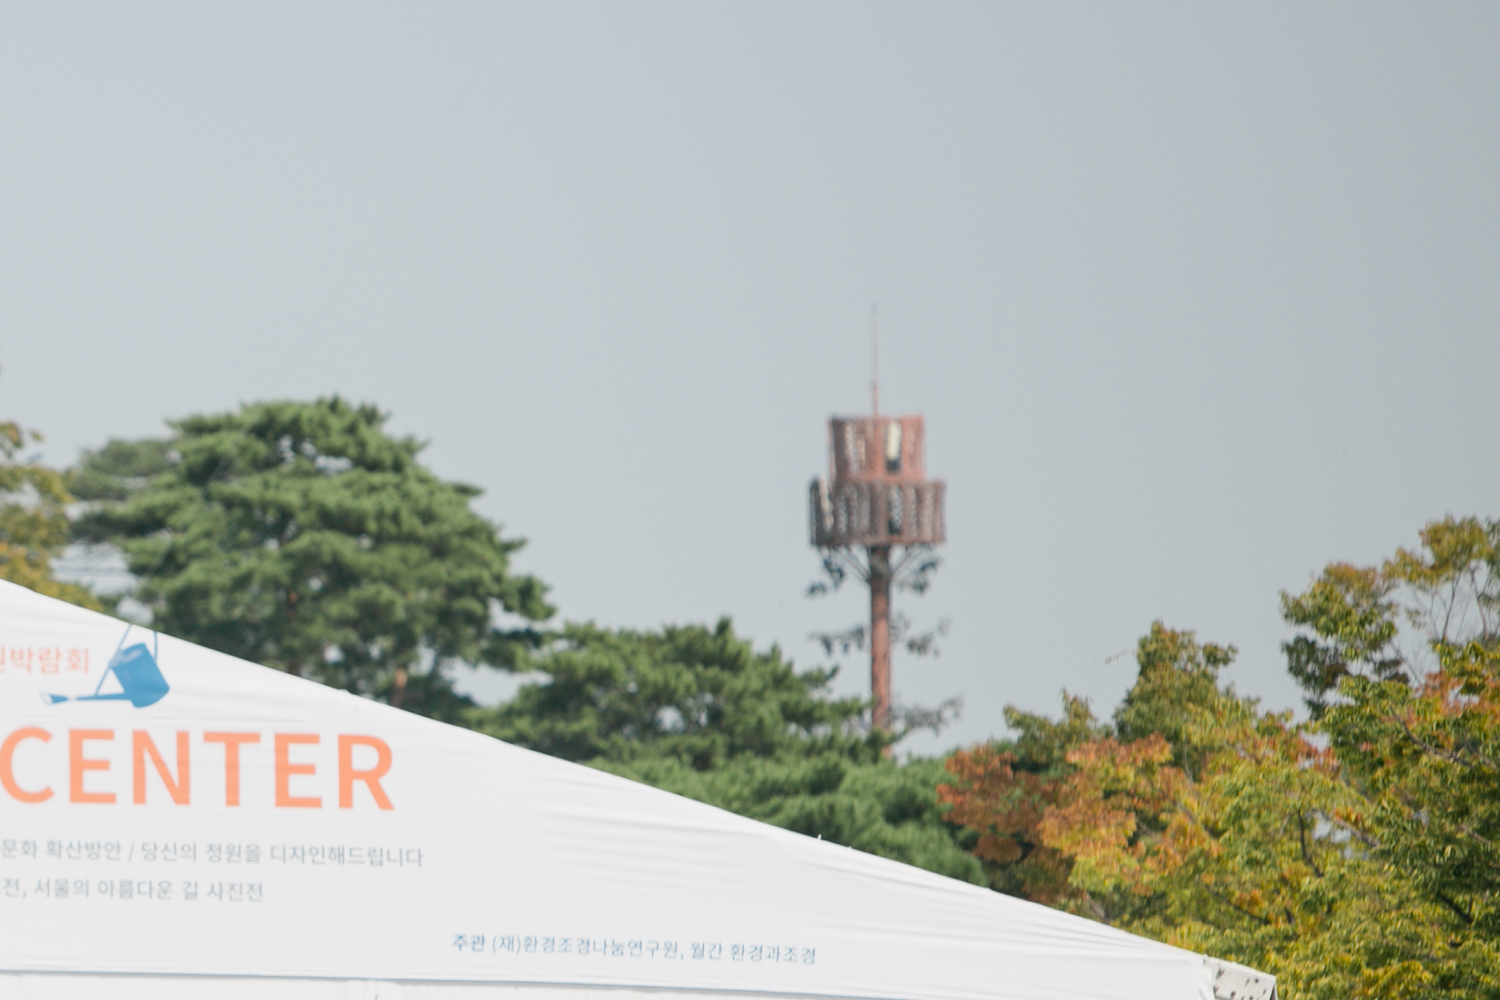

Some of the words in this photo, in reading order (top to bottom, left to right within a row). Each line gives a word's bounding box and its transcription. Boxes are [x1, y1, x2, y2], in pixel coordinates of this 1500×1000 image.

[46, 840, 123, 862] 확산방안
[141, 843, 199, 864] 당신의
[206, 844, 263, 866] 정원을
[270, 844, 425, 868] 디자인해드립니다
[34, 878, 91, 900] 서울의
[97, 880, 176, 902] 아름다운
[182, 881, 200, 903] 길
[206, 882, 265, 904] 사진전
[453, 934, 488, 953] 주관
[690, 942, 725, 962] 월간
[730, 943, 818, 967] 환경과조경
